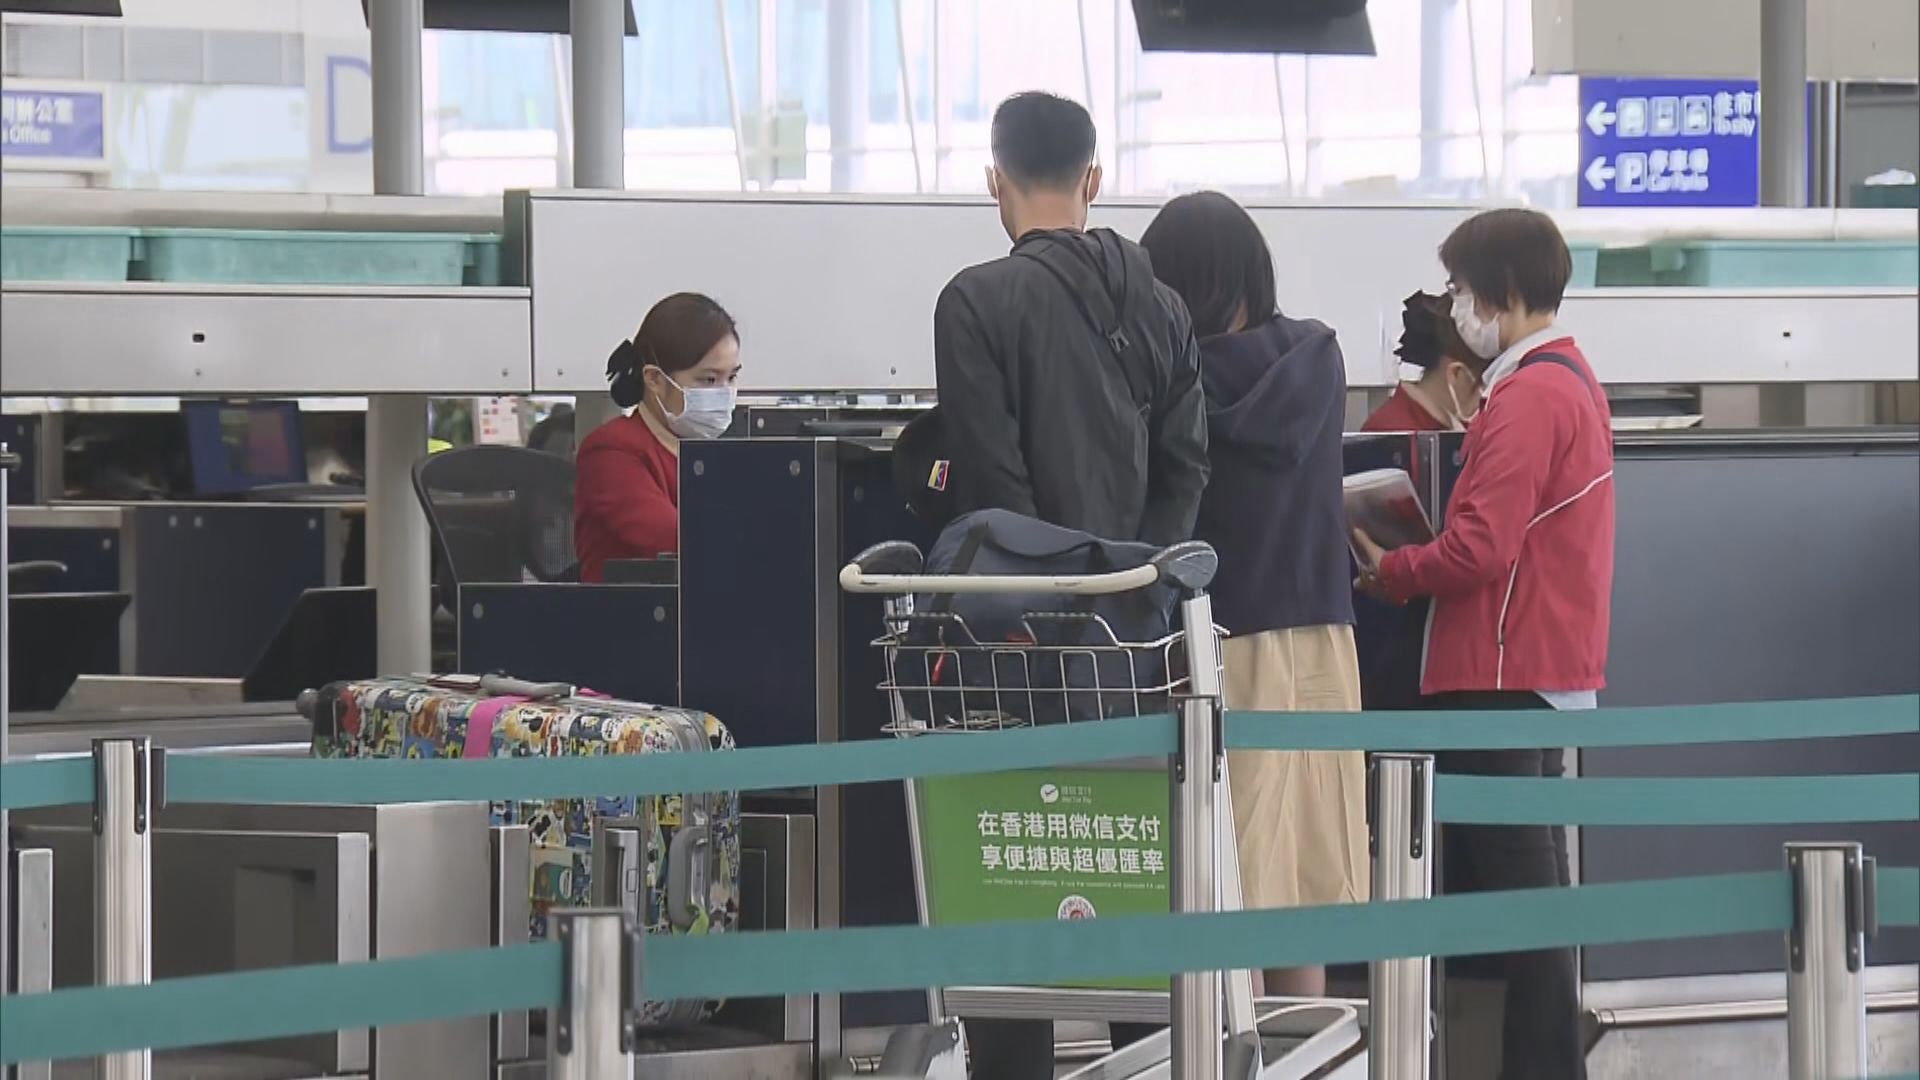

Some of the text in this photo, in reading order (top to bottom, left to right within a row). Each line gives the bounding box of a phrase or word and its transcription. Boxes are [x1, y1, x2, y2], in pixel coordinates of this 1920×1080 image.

[977, 810, 1161, 841] 在香港用微信支付
[980, 844, 1165, 874] 享便捷與超優匯率
